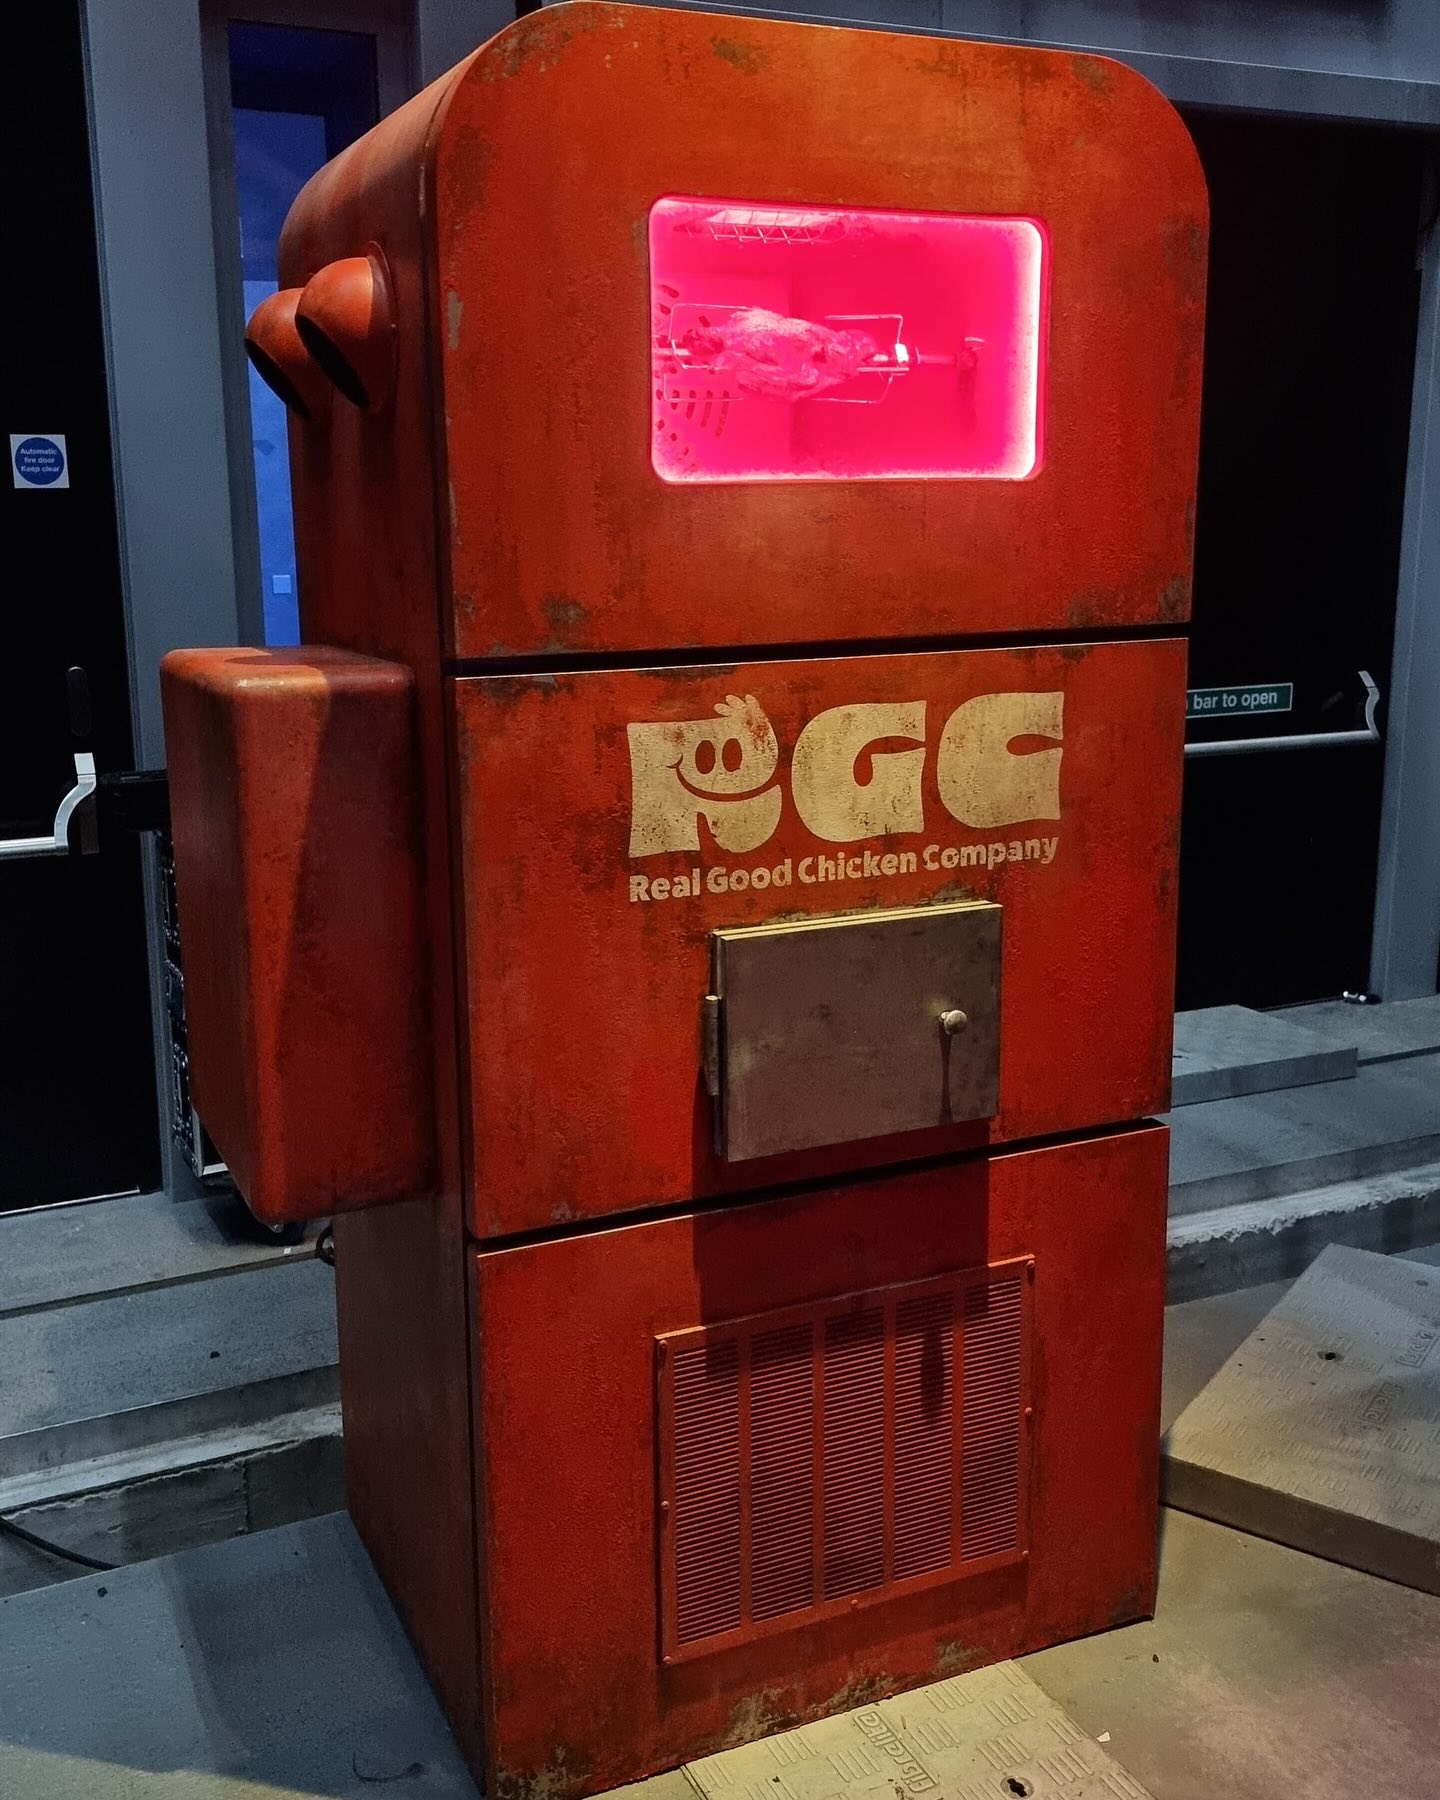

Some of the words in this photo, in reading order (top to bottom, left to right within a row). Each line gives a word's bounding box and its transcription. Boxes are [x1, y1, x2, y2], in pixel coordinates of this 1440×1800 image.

[24, 456, 36, 464] fire
[38, 456, 55, 464] door
[21, 465, 40, 473] Keep
[1193, 694, 1218, 710] bar
[1222, 693, 1237, 708] to
[1241, 691, 1278, 710] open
[629, 867, 700, 902] Real
[706, 858, 792, 895] Good
[798, 848, 917, 885] Chicken
[923, 837, 1059, 872] Company
